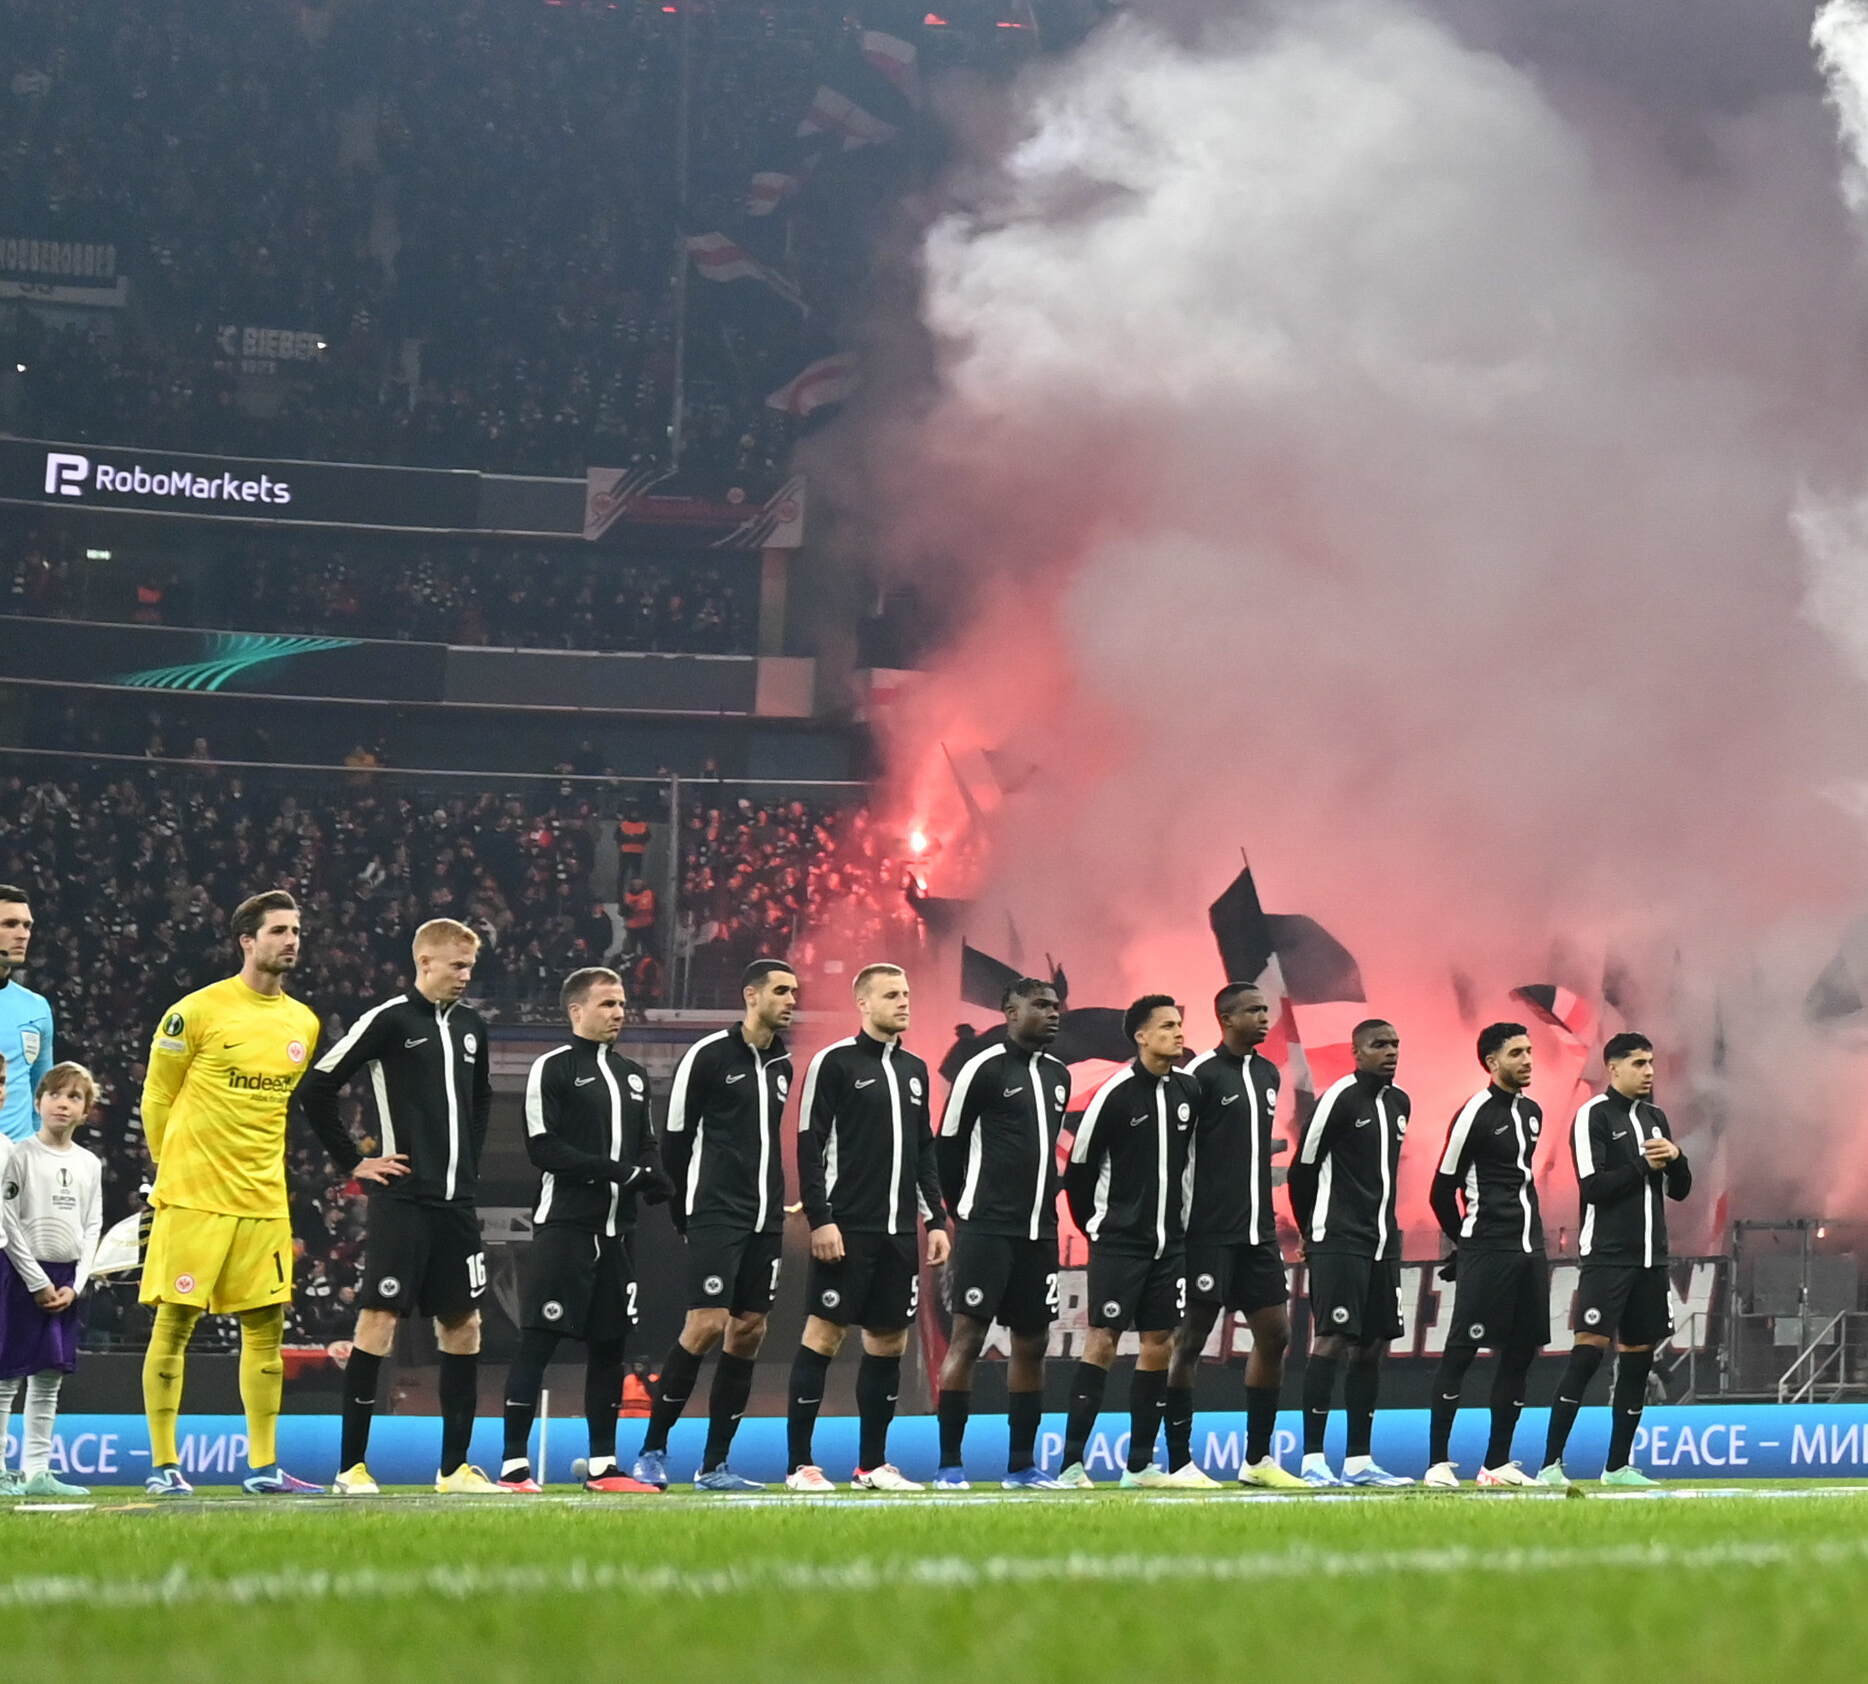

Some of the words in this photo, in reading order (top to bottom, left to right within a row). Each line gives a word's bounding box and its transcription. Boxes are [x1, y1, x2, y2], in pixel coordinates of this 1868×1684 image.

[95, 464, 292, 505] RoboMarkets
[273, 1250, 285, 1283] 1
[466, 1253, 487, 1288] 16
[5, 1433, 118, 1474] PACE
[1203, 1430, 1296, 1470] МР
[1628, 1424, 1749, 1466] PEACE
